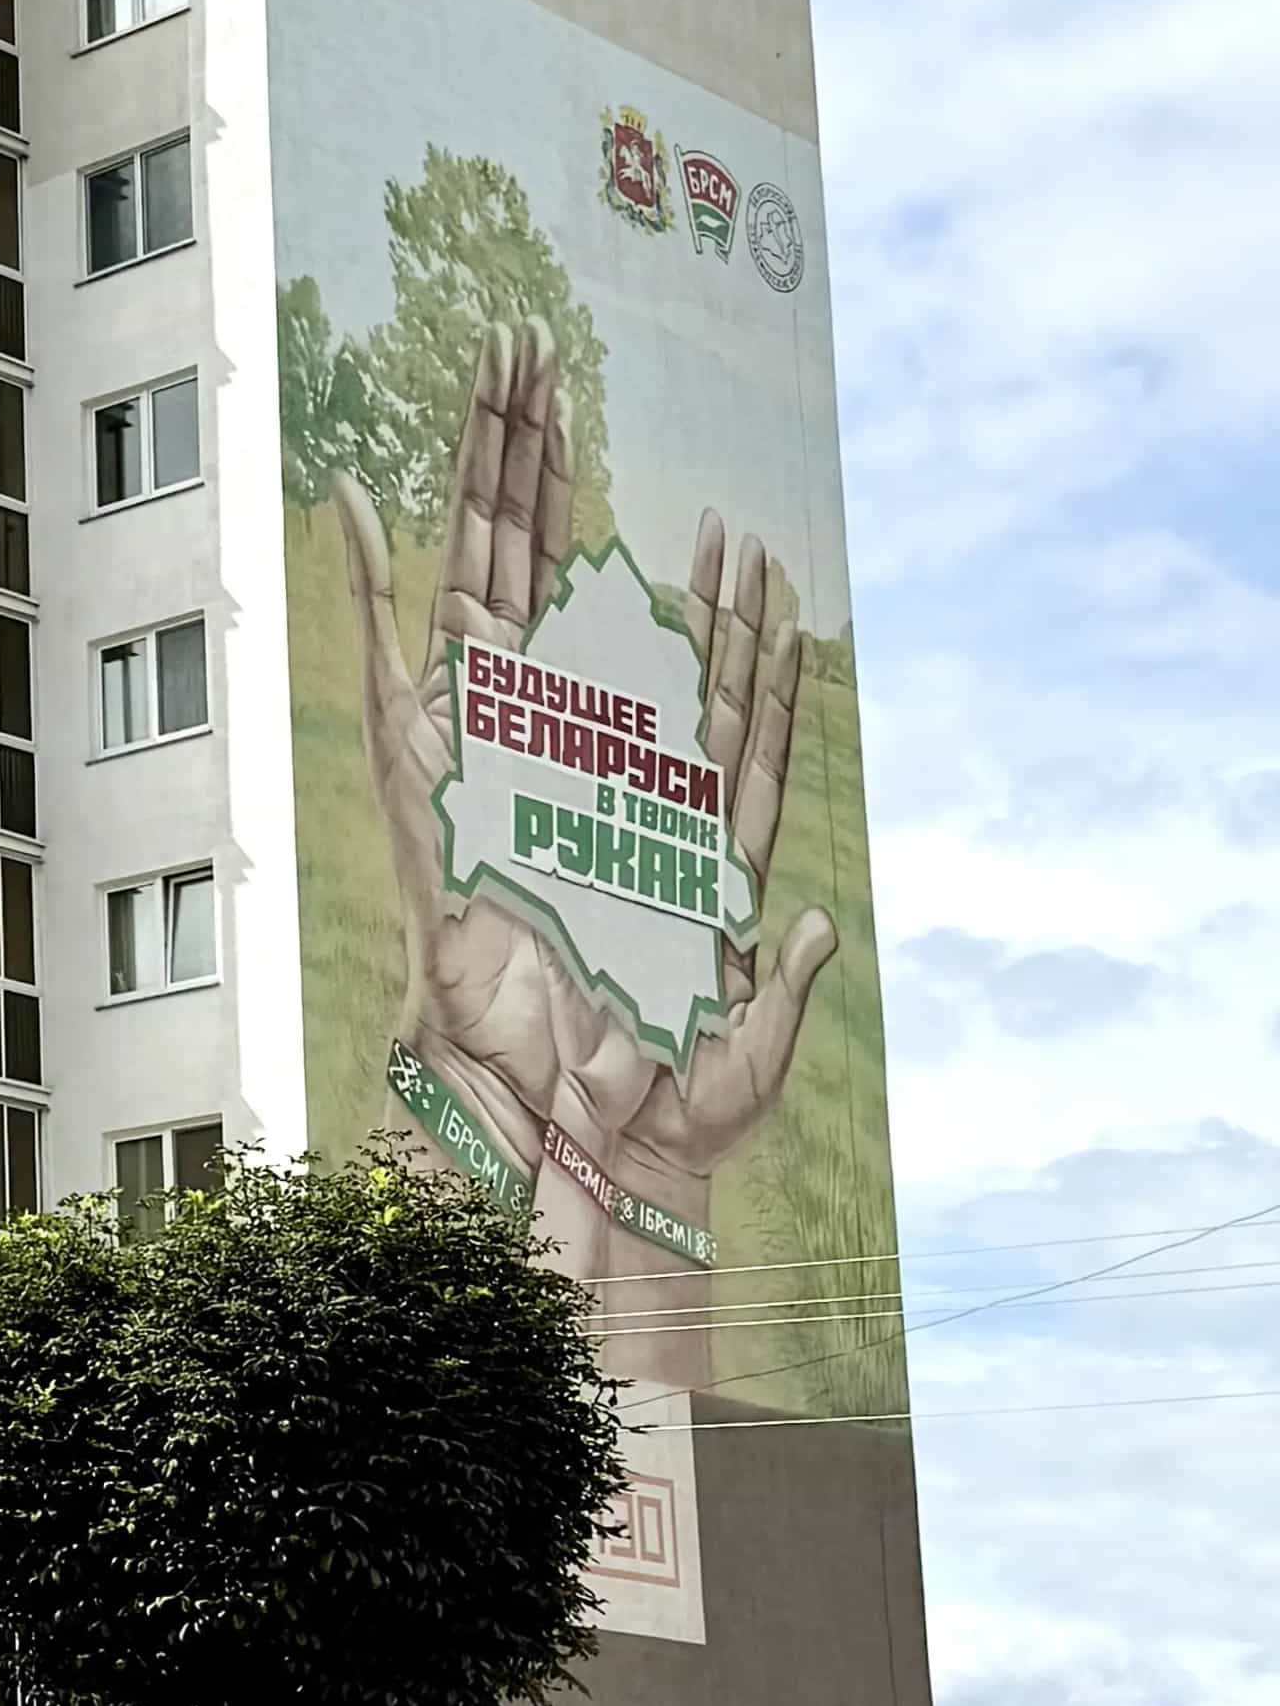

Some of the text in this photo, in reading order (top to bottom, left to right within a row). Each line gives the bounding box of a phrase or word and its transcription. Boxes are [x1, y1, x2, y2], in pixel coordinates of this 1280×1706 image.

[687, 165, 733, 212] БРСМ
[467, 645, 658, 745] БУДУЩЕЕ
[465, 688, 719, 818] БЕЛАРУСИ
[513, 792, 719, 920] РУКАХ
[596, 782, 719, 853] В ТВОИХ
[644, 1211, 686, 1246] БРСМ
